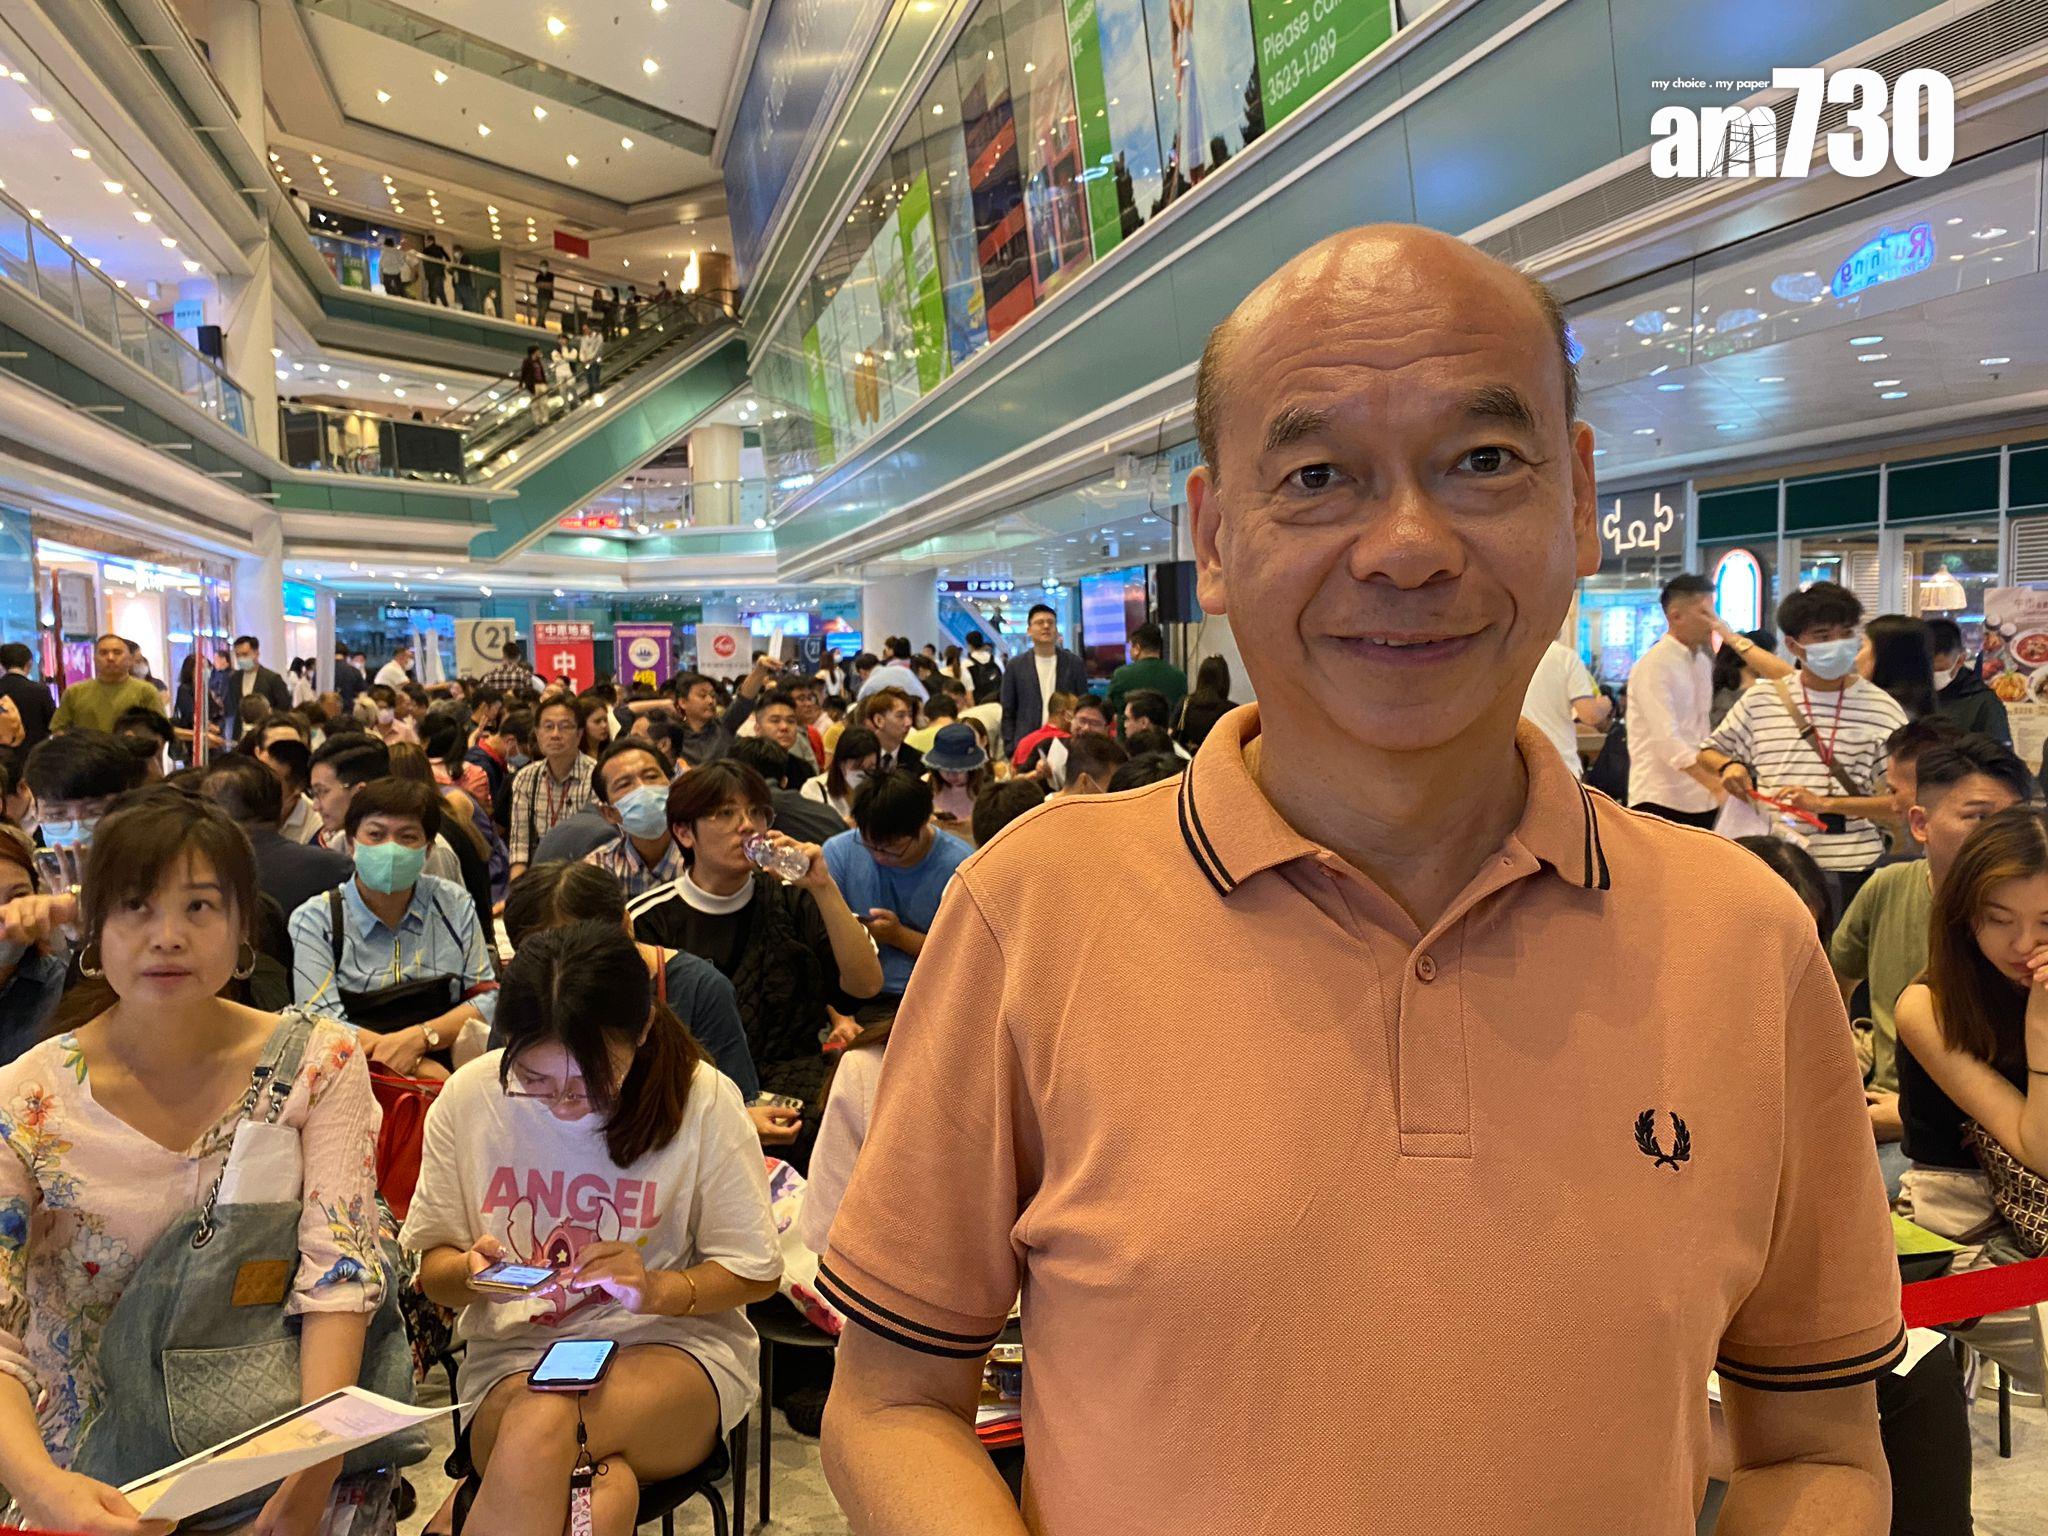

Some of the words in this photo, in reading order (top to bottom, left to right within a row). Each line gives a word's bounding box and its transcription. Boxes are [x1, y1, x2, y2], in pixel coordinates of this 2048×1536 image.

[1263, 11, 1310, 65] Please
[1313, 0, 1342, 22] ca
[1268, 28, 1336, 105] 3523-1289
[485, 626, 510, 649] 21
[480, 1166, 662, 1229] ANGEL
